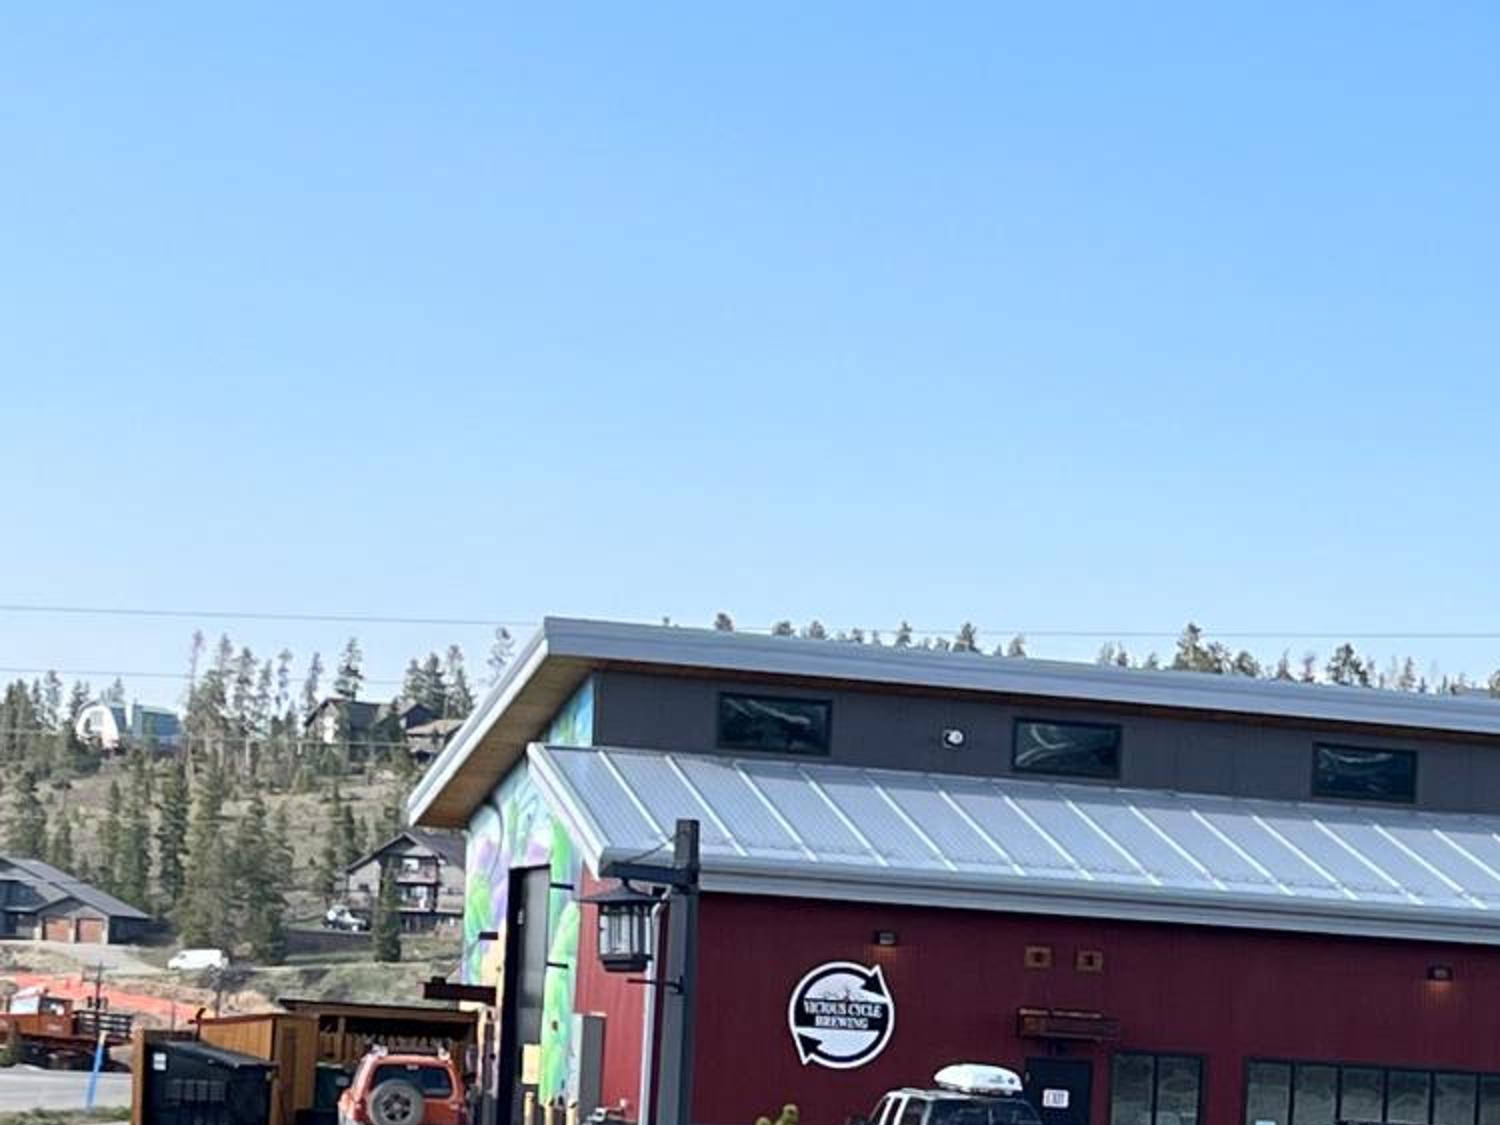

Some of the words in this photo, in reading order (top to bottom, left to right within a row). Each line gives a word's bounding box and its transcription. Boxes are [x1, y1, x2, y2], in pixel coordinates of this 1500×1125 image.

[804, 1001, 847, 1015] VICIOUS
[848, 1003, 882, 1018] CYCLE
[815, 1015, 869, 1029] BREWING
